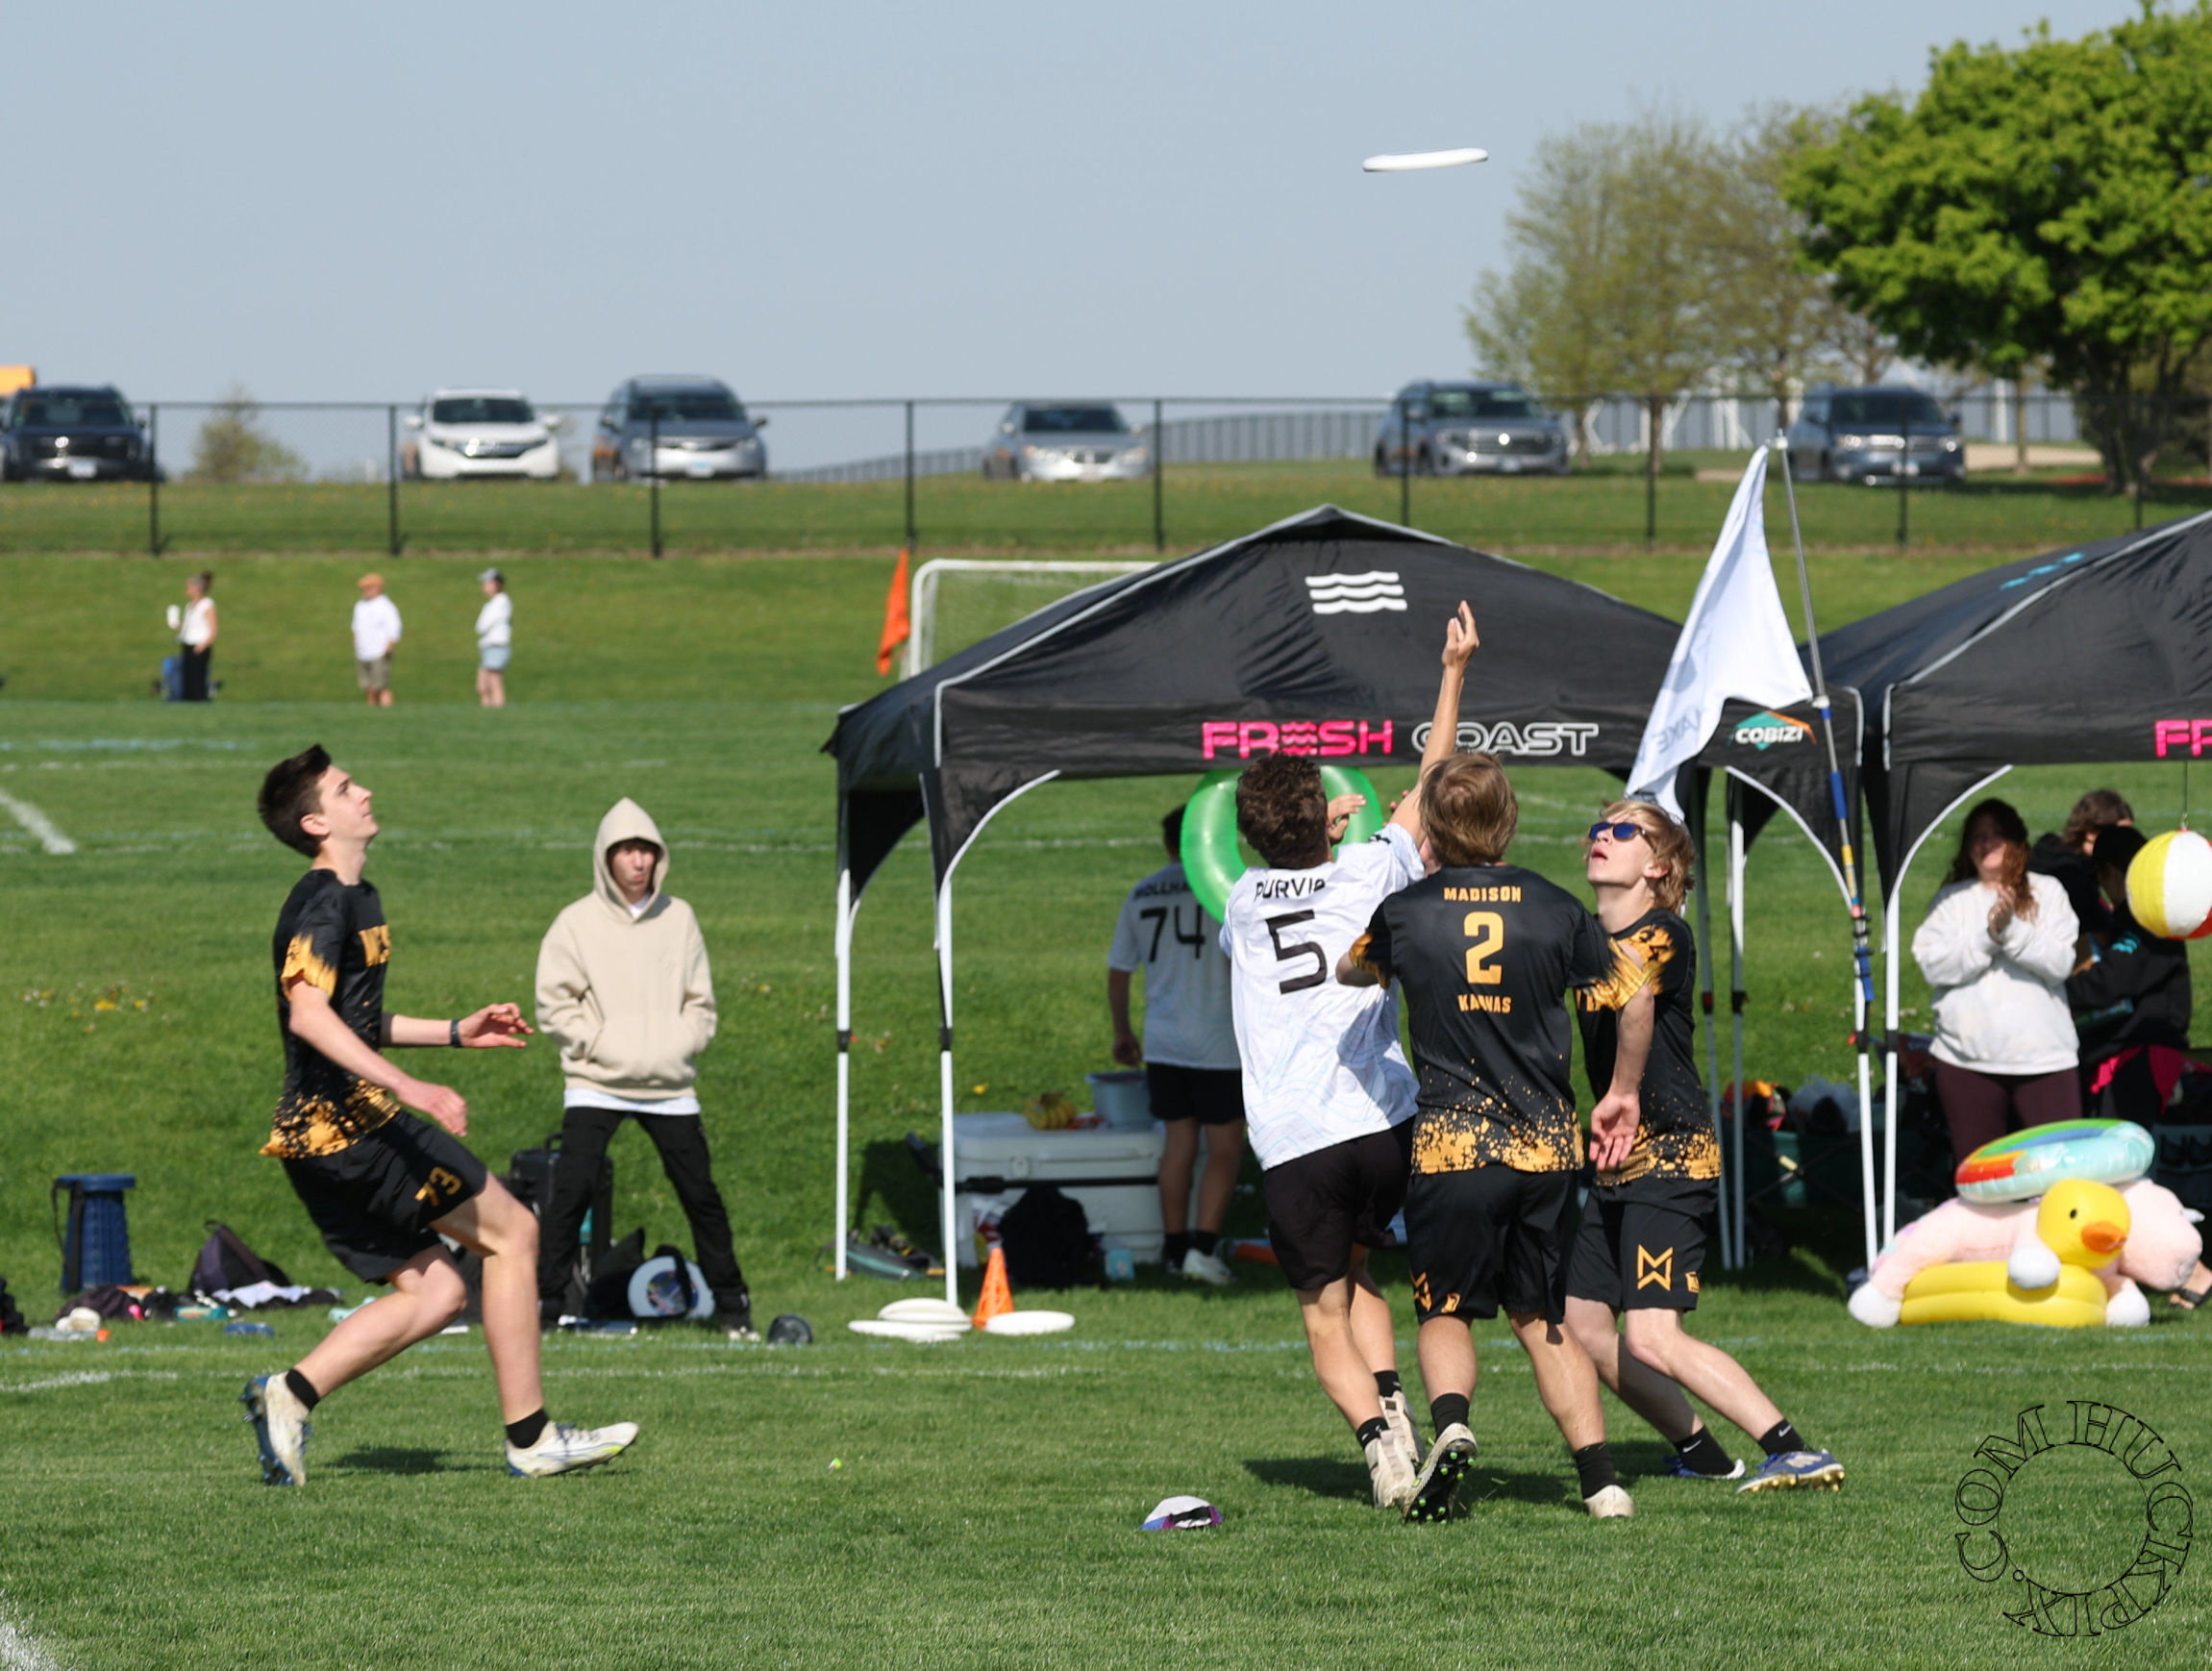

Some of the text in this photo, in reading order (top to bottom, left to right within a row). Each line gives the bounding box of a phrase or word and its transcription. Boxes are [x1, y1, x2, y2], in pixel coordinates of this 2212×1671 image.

[1202, 720, 1393, 759] FRESH
[1735, 726, 1803, 744] COBIZI
[1443, 885, 1522, 903] MADISON
[1140, 904, 1205, 963] 74
[1265, 909, 1328, 995] 5
[1463, 910, 1504, 985] 2
[414, 1166, 461, 1208] 73
